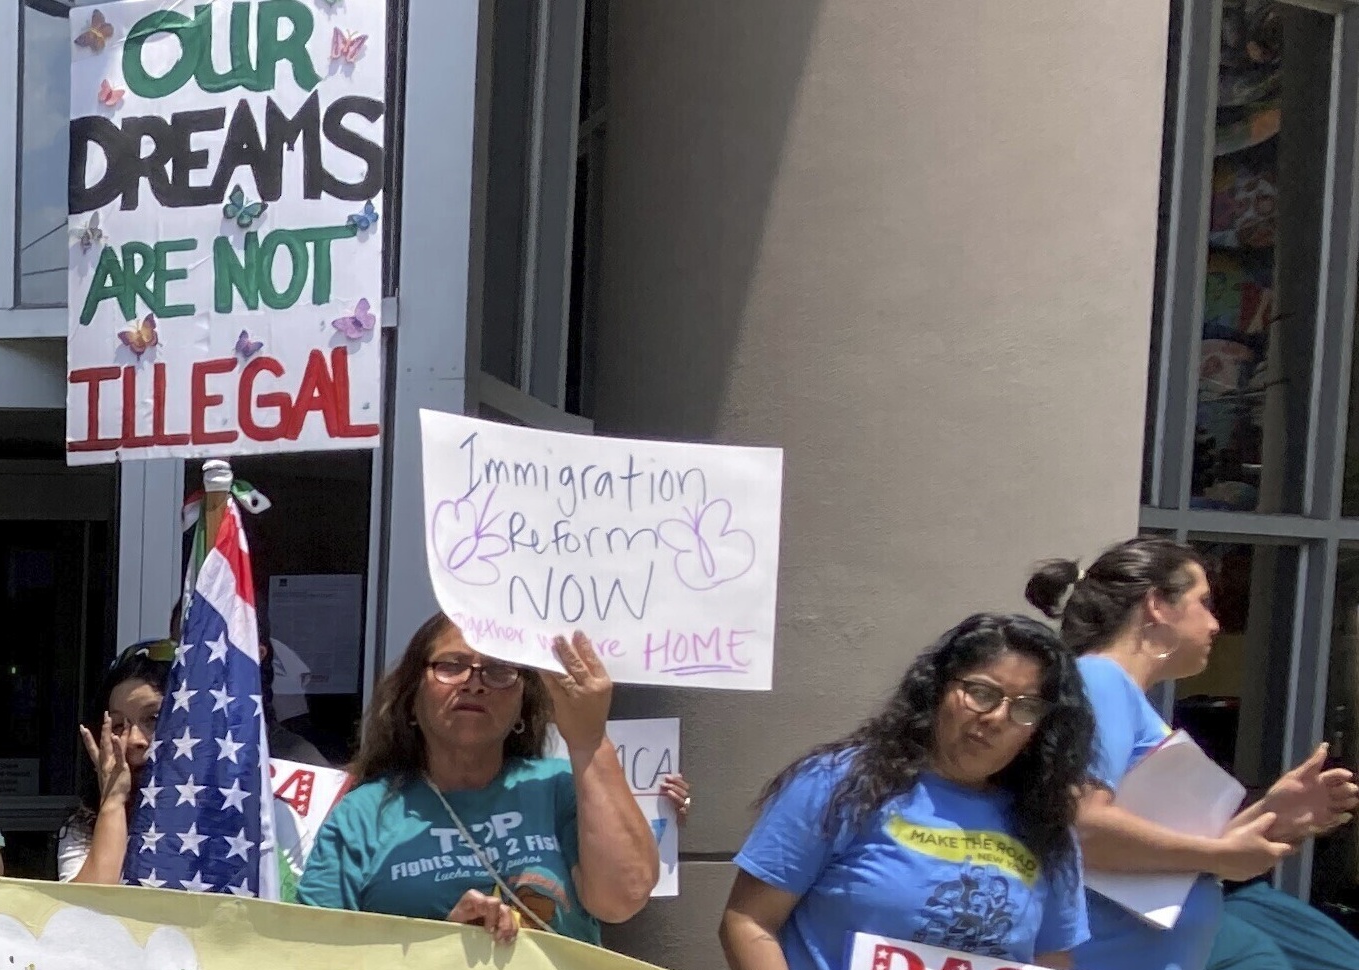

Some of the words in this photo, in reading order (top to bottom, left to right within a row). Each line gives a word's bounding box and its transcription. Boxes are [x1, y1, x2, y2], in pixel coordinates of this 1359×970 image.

[122, 0, 324, 98] OUR
[68, 90, 384, 215] DREAMS
[80, 238, 197, 325] ARE
[213, 223, 357, 314] NOT
[68, 346, 379, 452] ILLEGAL
[460, 432, 706, 517] Immigration
[509, 511, 658, 557] Reform
[510, 561, 654, 622] NOW
[596, 637, 627, 658] re
[644, 627, 756, 670] HOME
[456, 847, 500, 867] wih
[506, 838, 521, 856] 2
[910, 829, 959, 849] MAKE
[961, 837, 993, 850] THE
[996, 841, 1038, 872] ROAD
